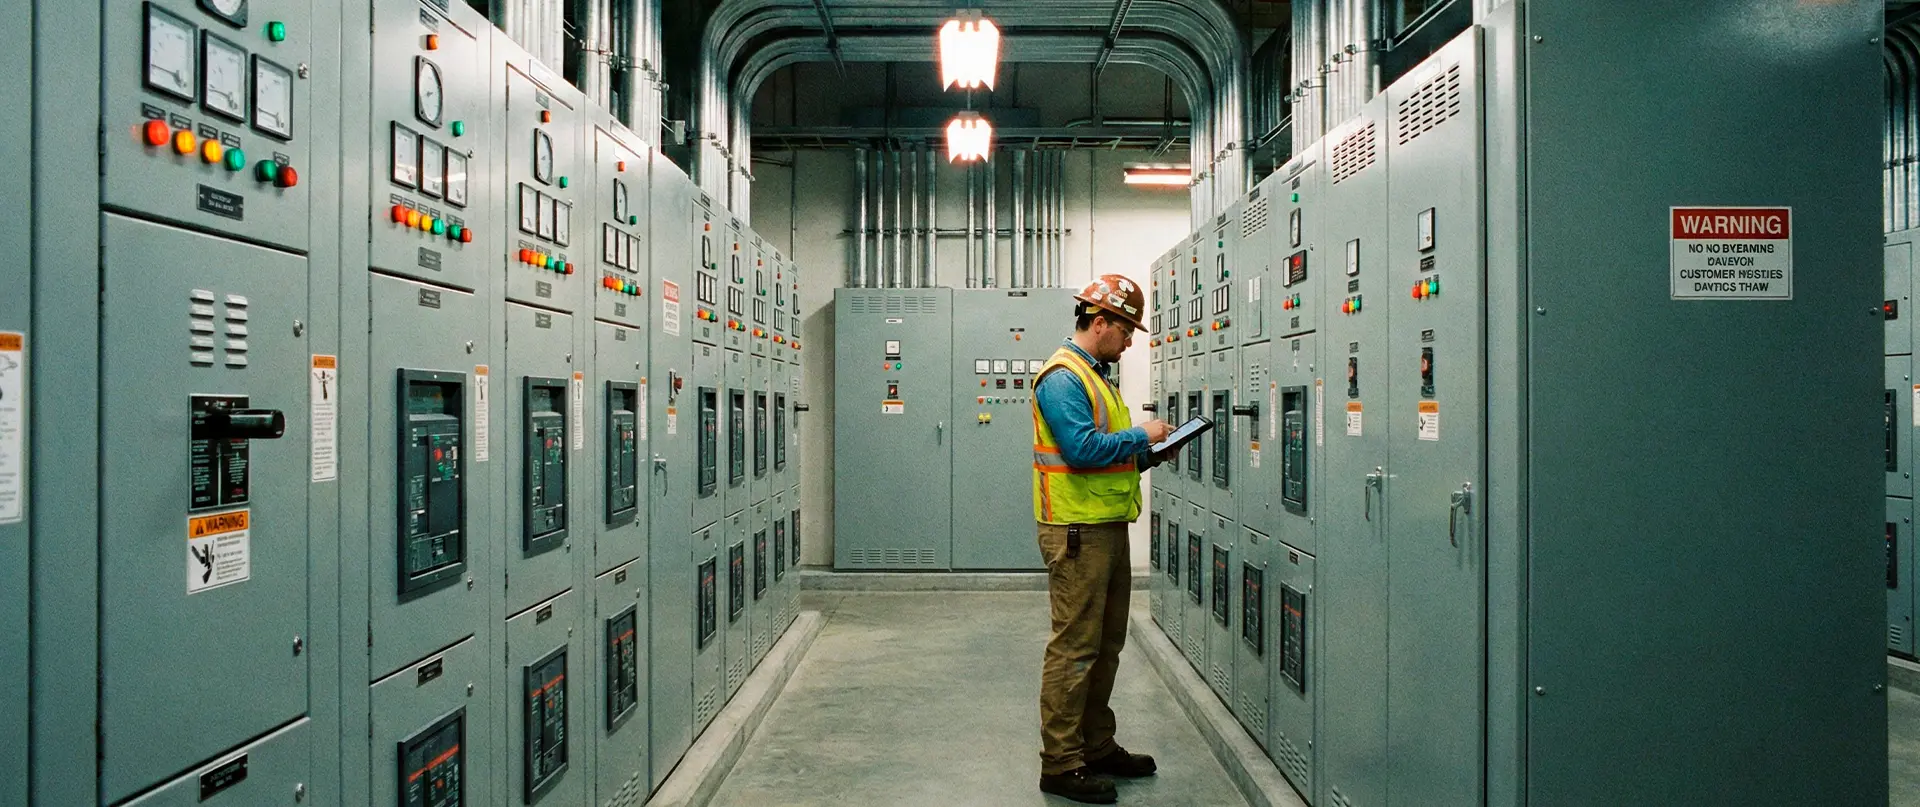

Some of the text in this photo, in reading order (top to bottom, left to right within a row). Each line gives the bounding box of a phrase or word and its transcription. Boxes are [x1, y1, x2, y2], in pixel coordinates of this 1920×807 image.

[1680, 215, 1782, 234] WARNING
[1688, 243, 1703, 253] NO
[1706, 243, 1720, 253] NO
[1680, 269, 1735, 279] CUSTOMER
[1739, 282, 1769, 292] THAW
[205, 514, 244, 532] WARNING
